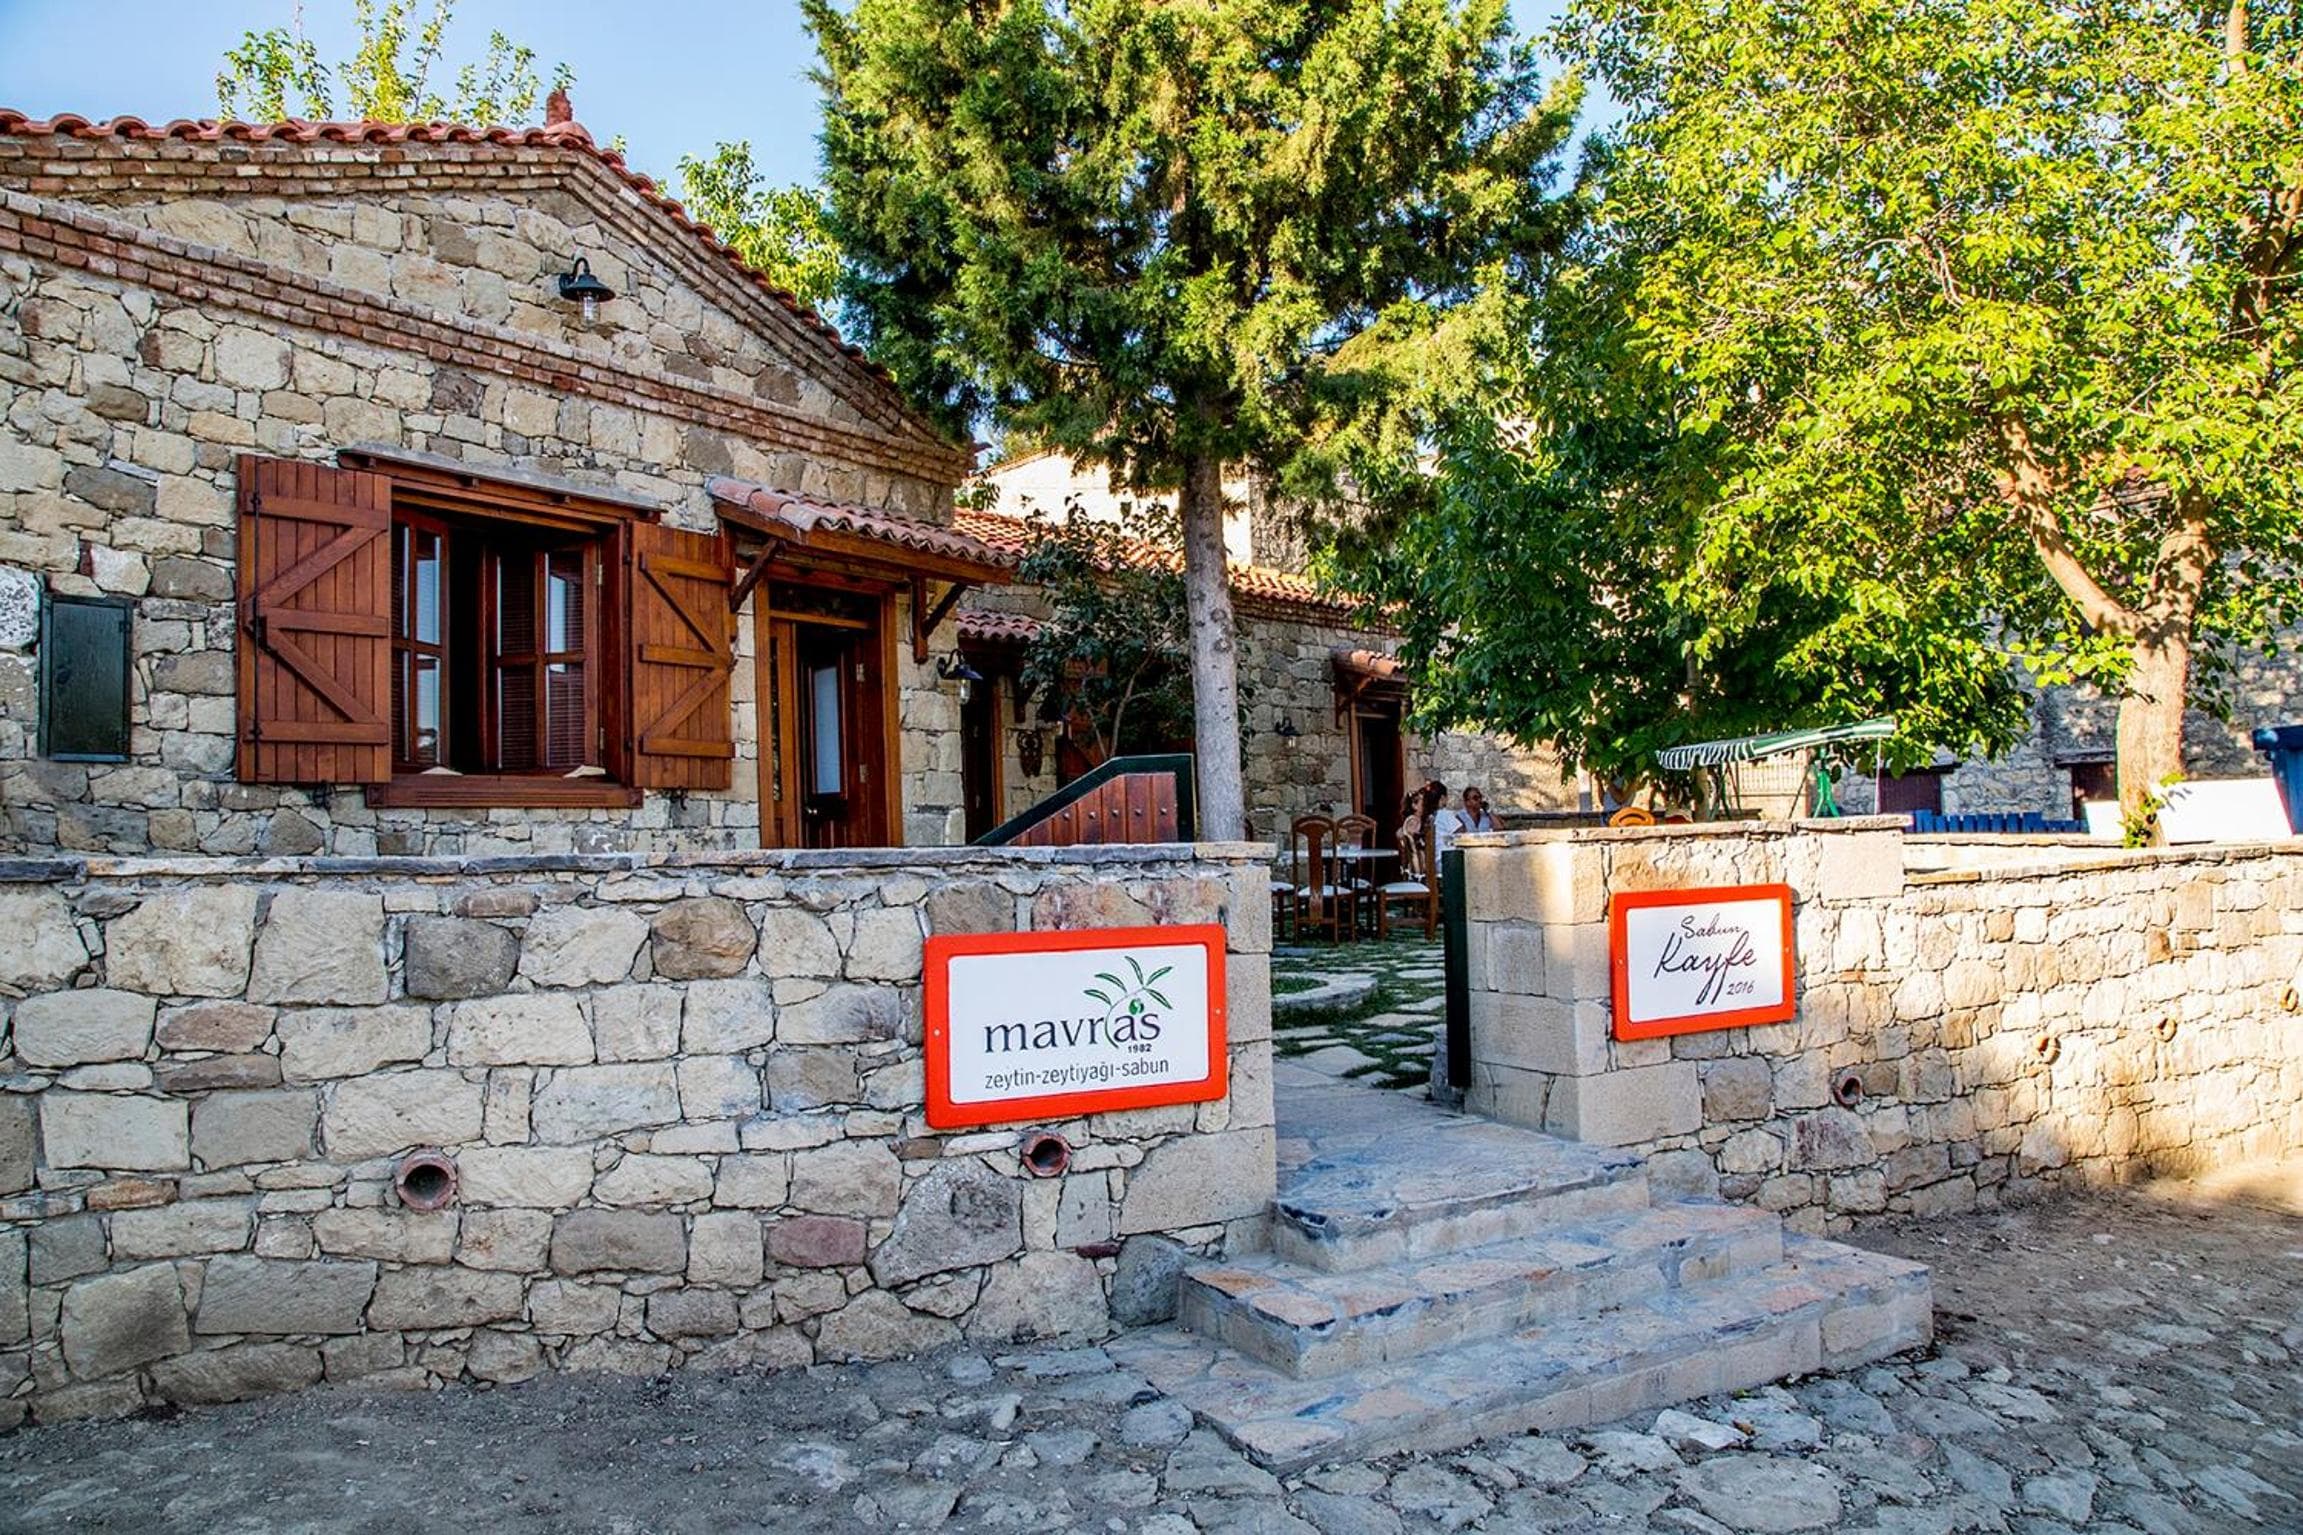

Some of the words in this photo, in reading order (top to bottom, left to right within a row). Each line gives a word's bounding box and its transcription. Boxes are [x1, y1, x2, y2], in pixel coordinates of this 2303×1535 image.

[1681, 913, 1742, 939] Sabun
[1654, 931, 1757, 1005] Kayfe
[1726, 980, 1755, 995] 2016
[985, 1013, 1161, 1053] mavras
[1127, 1044, 1153, 1054] 1982
